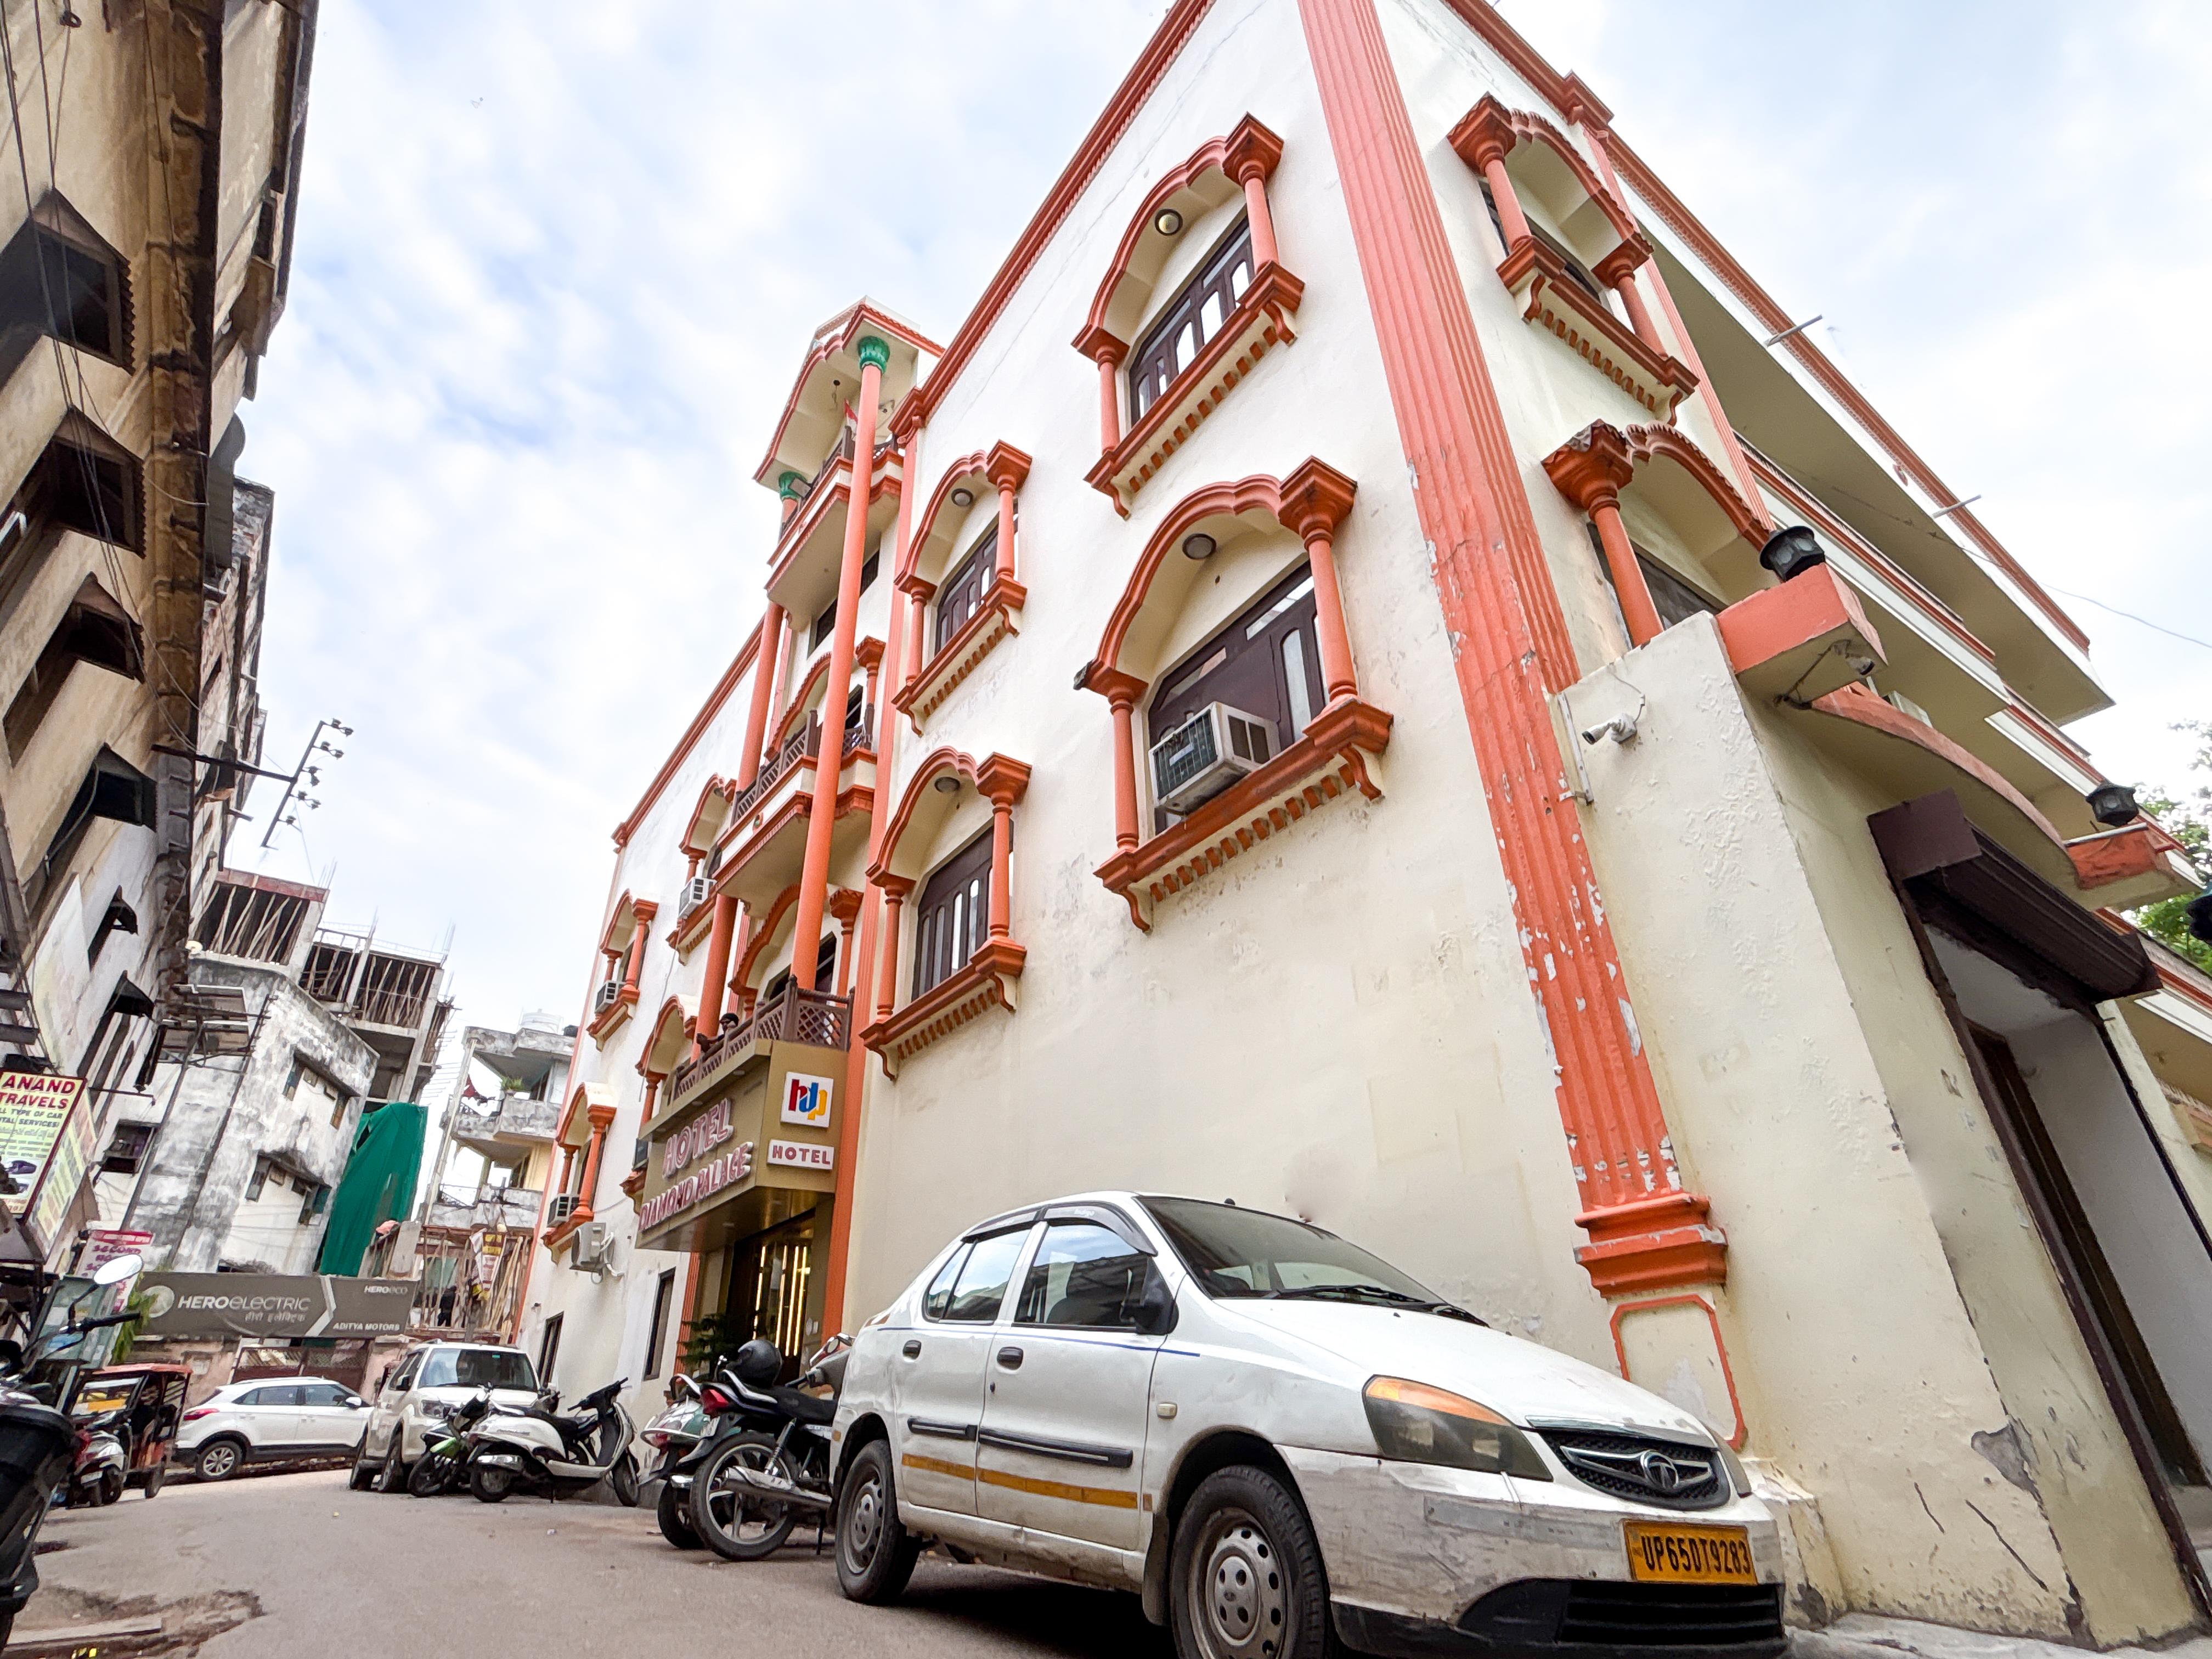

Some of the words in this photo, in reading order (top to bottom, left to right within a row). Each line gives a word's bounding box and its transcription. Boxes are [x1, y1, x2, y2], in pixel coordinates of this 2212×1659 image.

[2, 1075, 76, 1094] ANAND
[0, 1092, 69, 1109] TRAVELS
[663, 1098, 734, 1178] HOTEL
[772, 1144, 831, 1165] HOTEL
[638, 1176, 699, 1233] DIAMOND
[694, 1141, 754, 1203] PALACE
[332, 1322, 363, 1330] ADITYA
[365, 1323, 400, 1331] MOTORS
